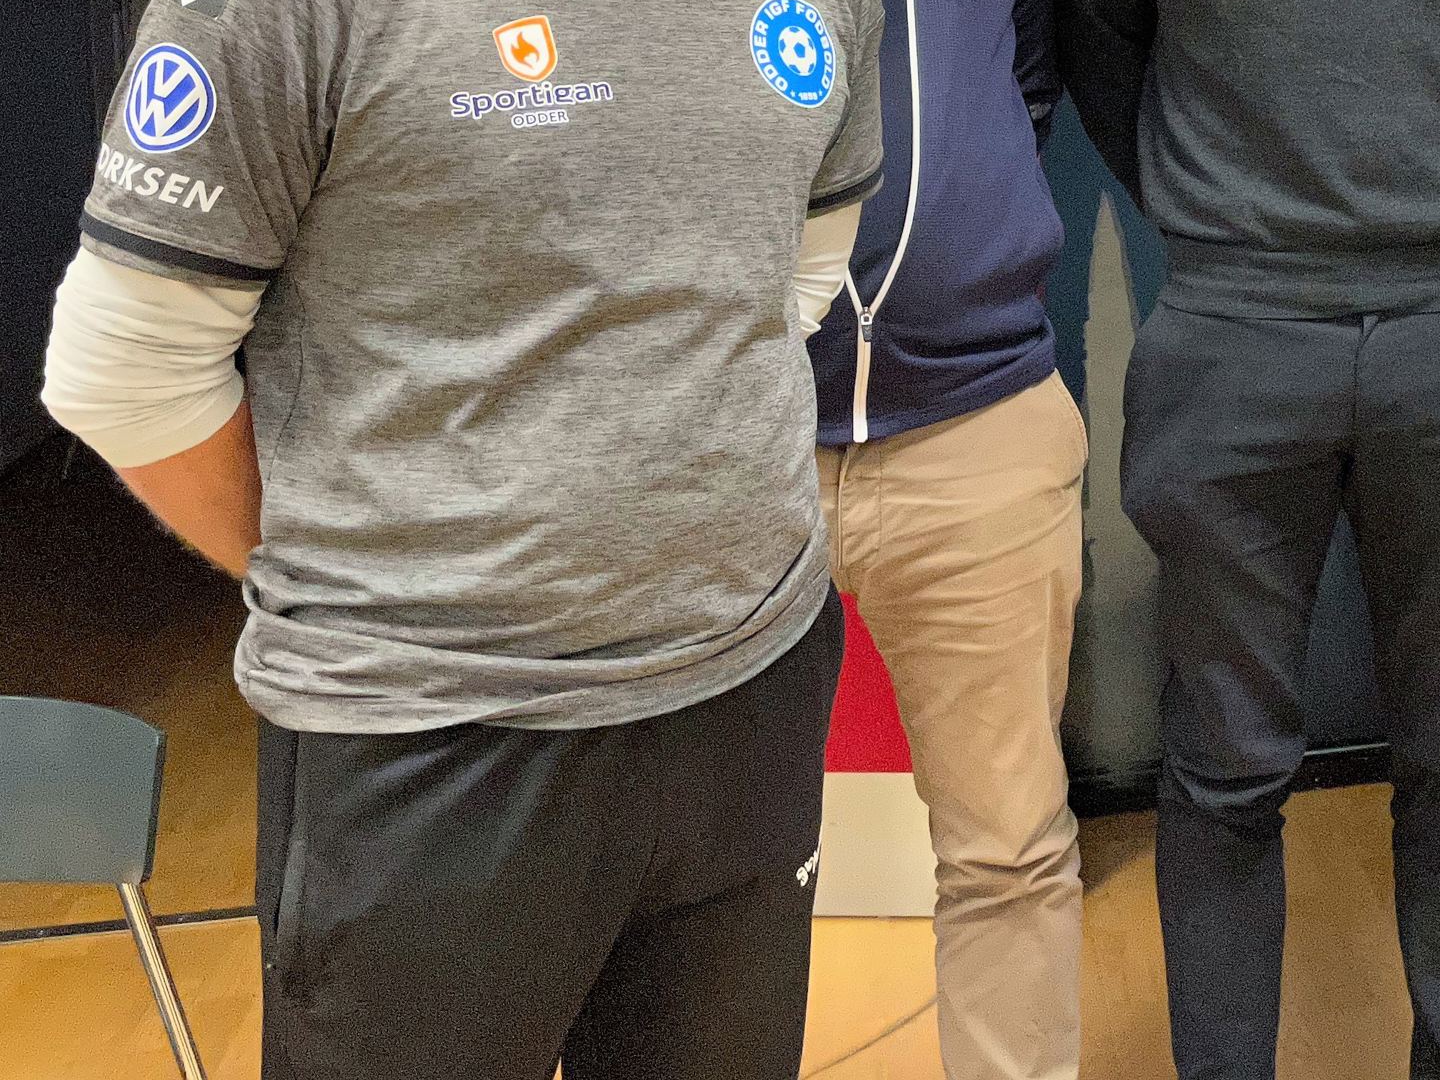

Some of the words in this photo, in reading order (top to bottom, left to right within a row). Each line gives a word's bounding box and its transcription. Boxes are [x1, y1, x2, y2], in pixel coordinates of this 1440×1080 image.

[763, 0, 790, 20] IGF
[753, 19, 789, 92] ODDER
[795, 2, 833, 90] FODBOLD
[450, 81, 613, 118] Sportigan
[512, 110, 568, 128] ODDER
